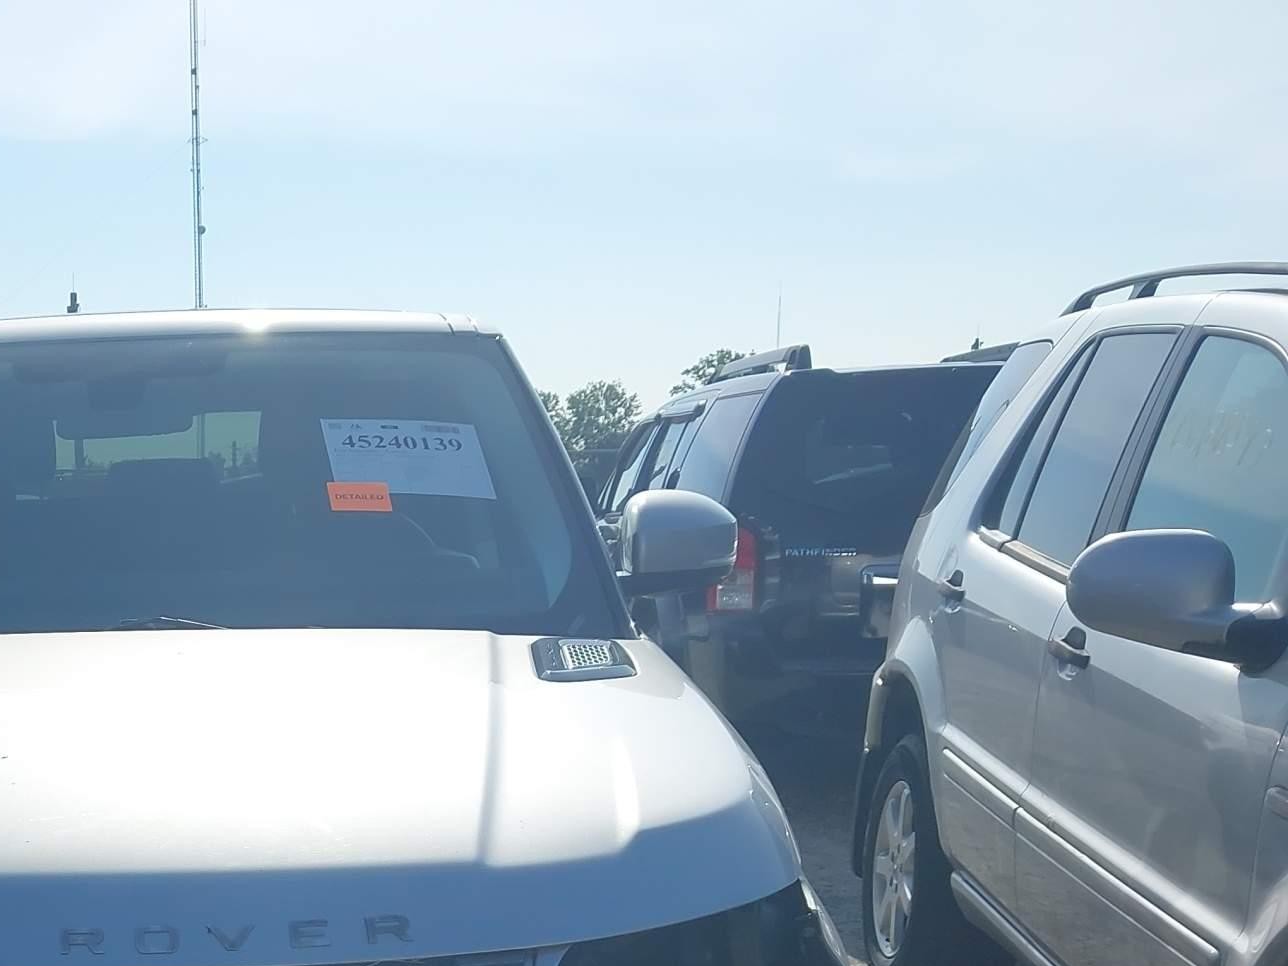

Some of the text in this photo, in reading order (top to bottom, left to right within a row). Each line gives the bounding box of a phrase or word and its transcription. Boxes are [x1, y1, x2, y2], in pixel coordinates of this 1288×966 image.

[341, 434, 463, 452] 45240139
[784, 547, 857, 557] PATHFINDER
[59, 913, 414, 955] ROVER
